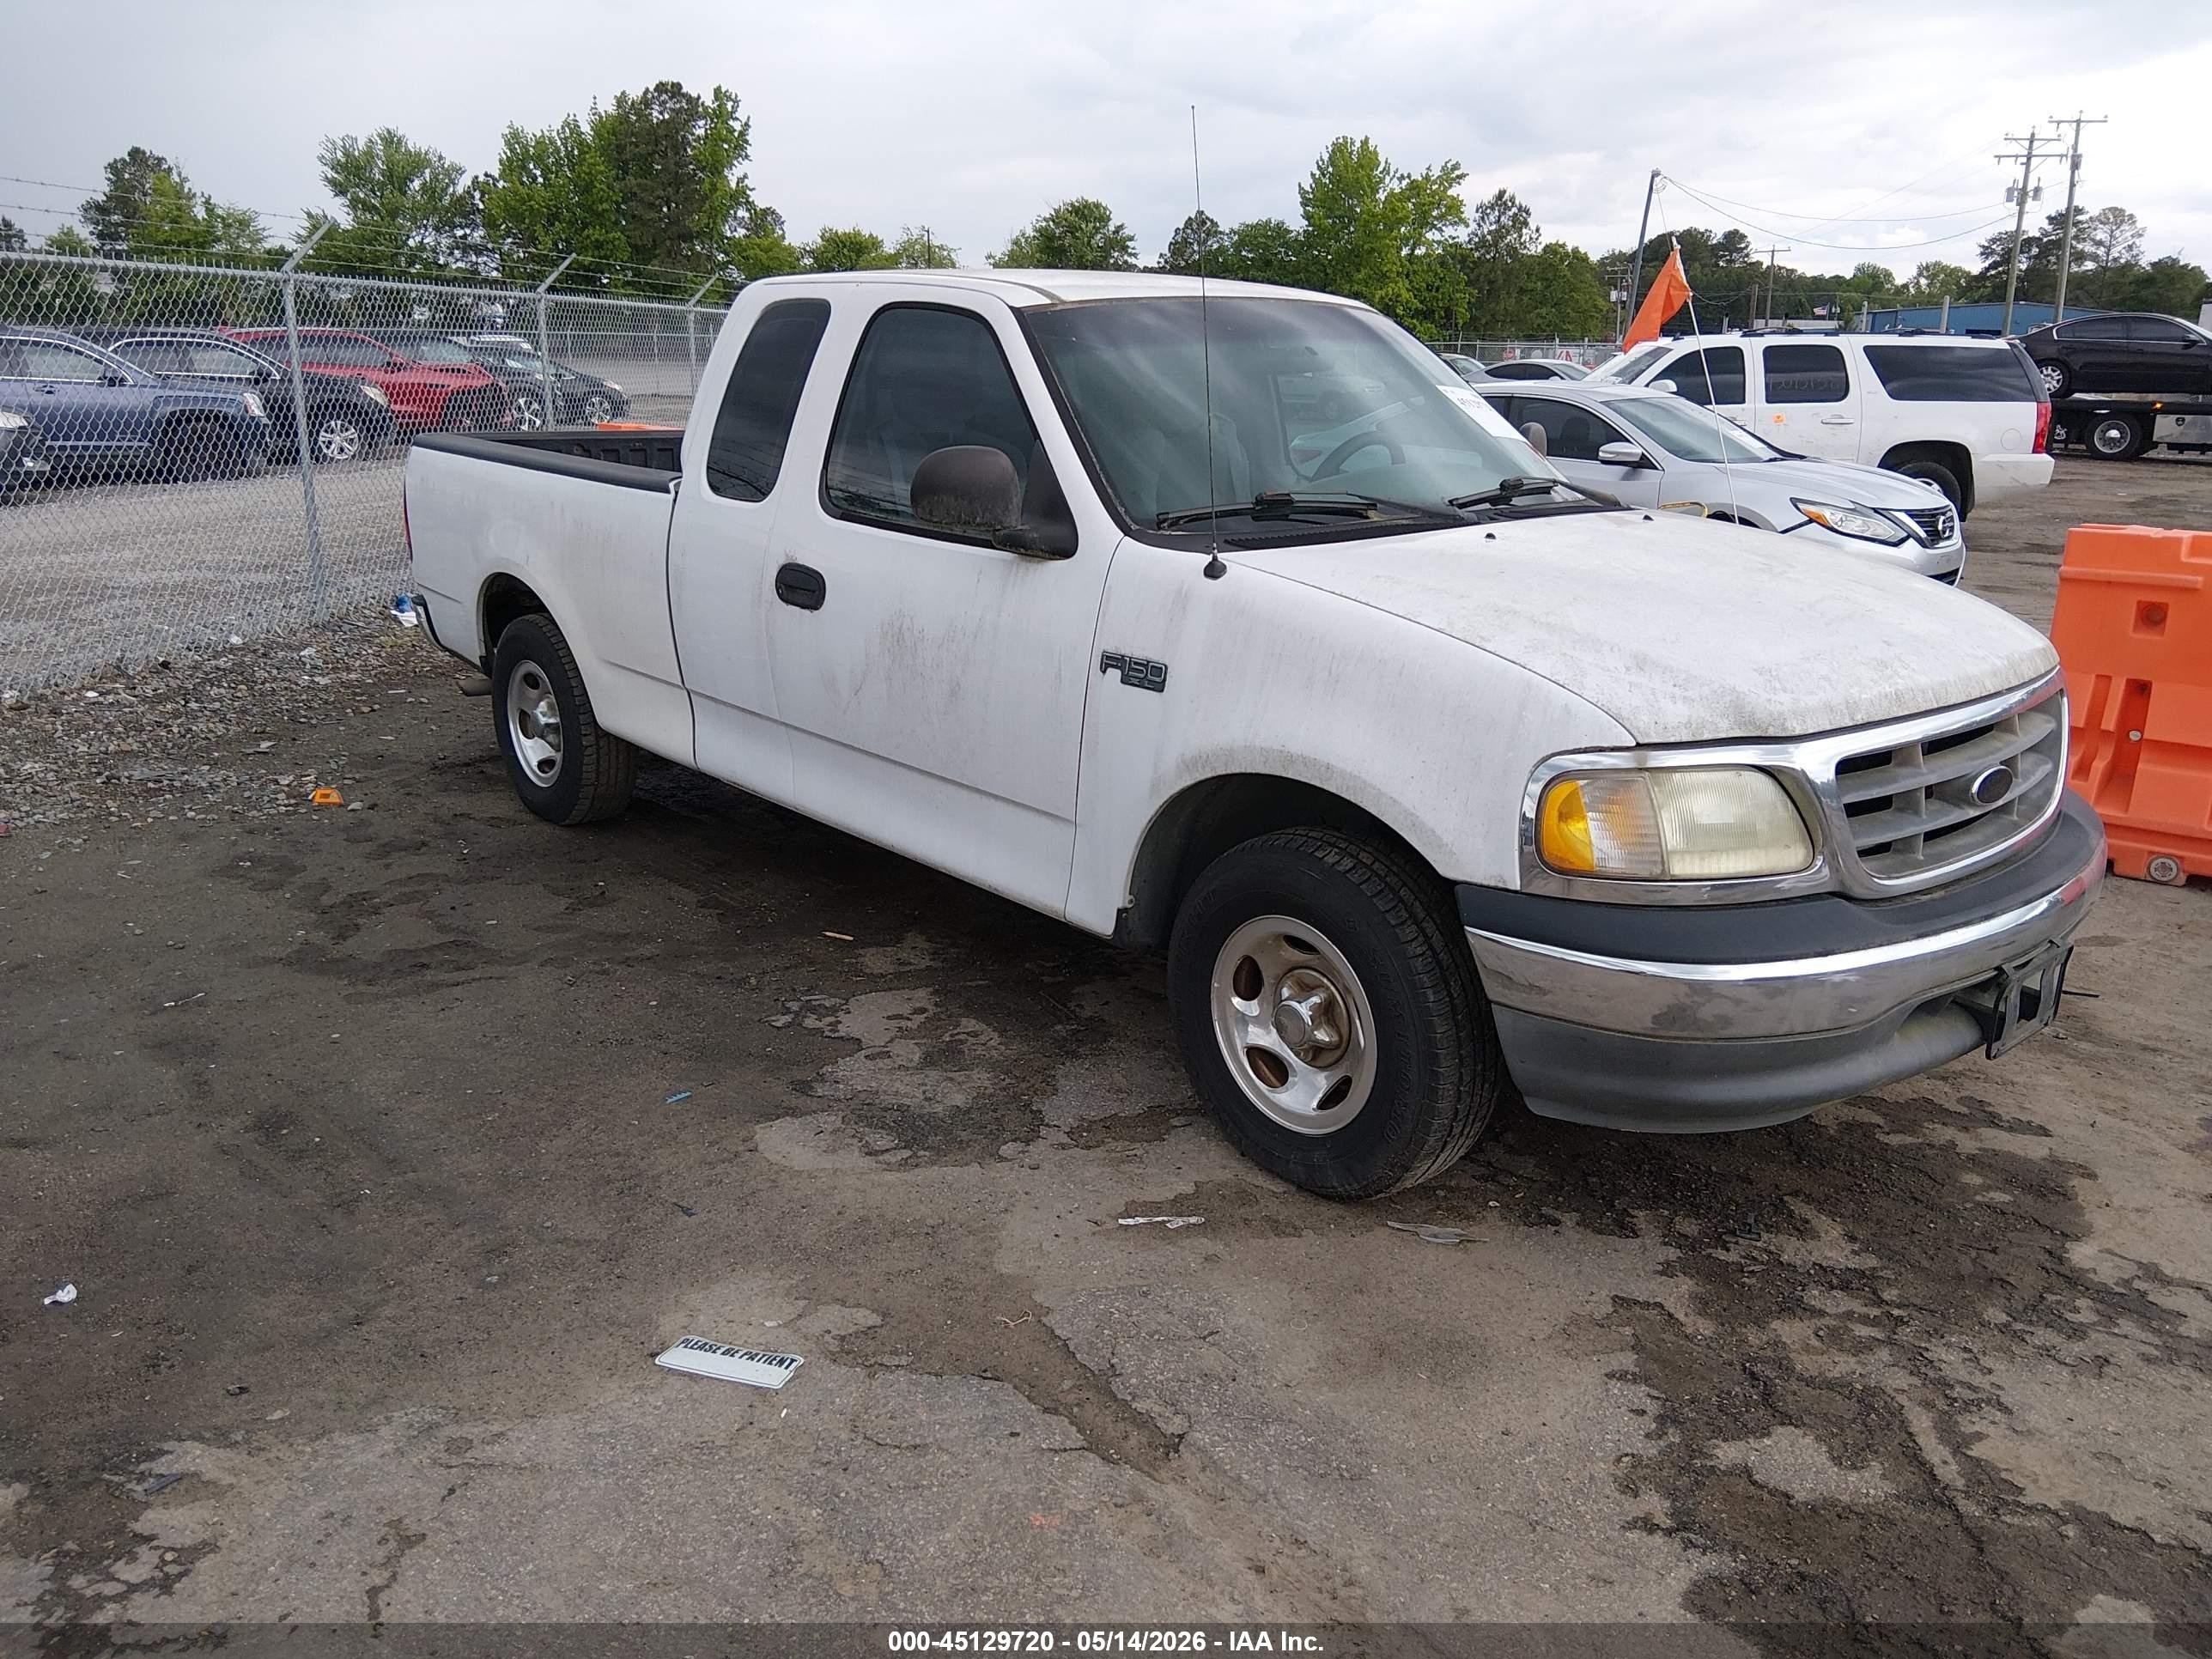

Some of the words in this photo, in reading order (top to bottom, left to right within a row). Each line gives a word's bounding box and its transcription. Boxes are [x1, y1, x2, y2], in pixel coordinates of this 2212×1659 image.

[1128, 678, 1155, 688] XL
[675, 1338, 720, 1354] PLEASE
[721, 1346, 739, 1358] BE
[738, 1352, 798, 1370] PATIENT
